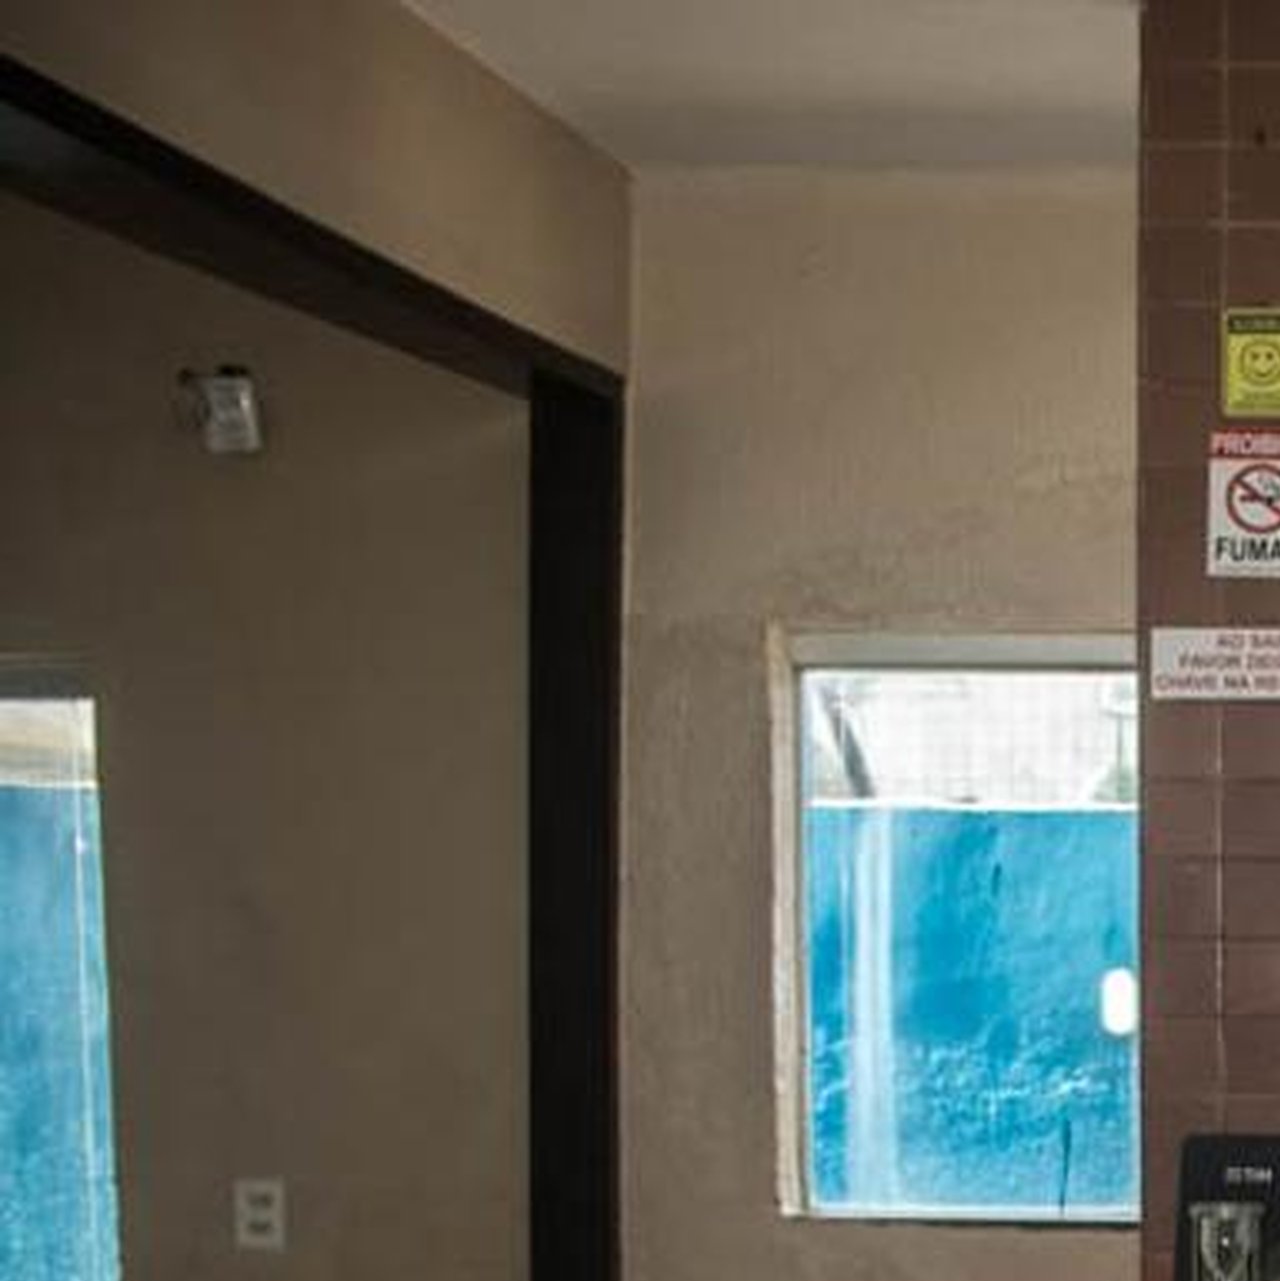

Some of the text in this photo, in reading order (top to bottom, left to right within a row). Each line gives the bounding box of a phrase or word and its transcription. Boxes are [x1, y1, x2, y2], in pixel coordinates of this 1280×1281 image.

[1217, 634, 1245, 649] AO
[1178, 653, 1241, 669] FAVOR
[1156, 674, 1218, 690] CHAVE
[1223, 674, 1250, 690] NA
